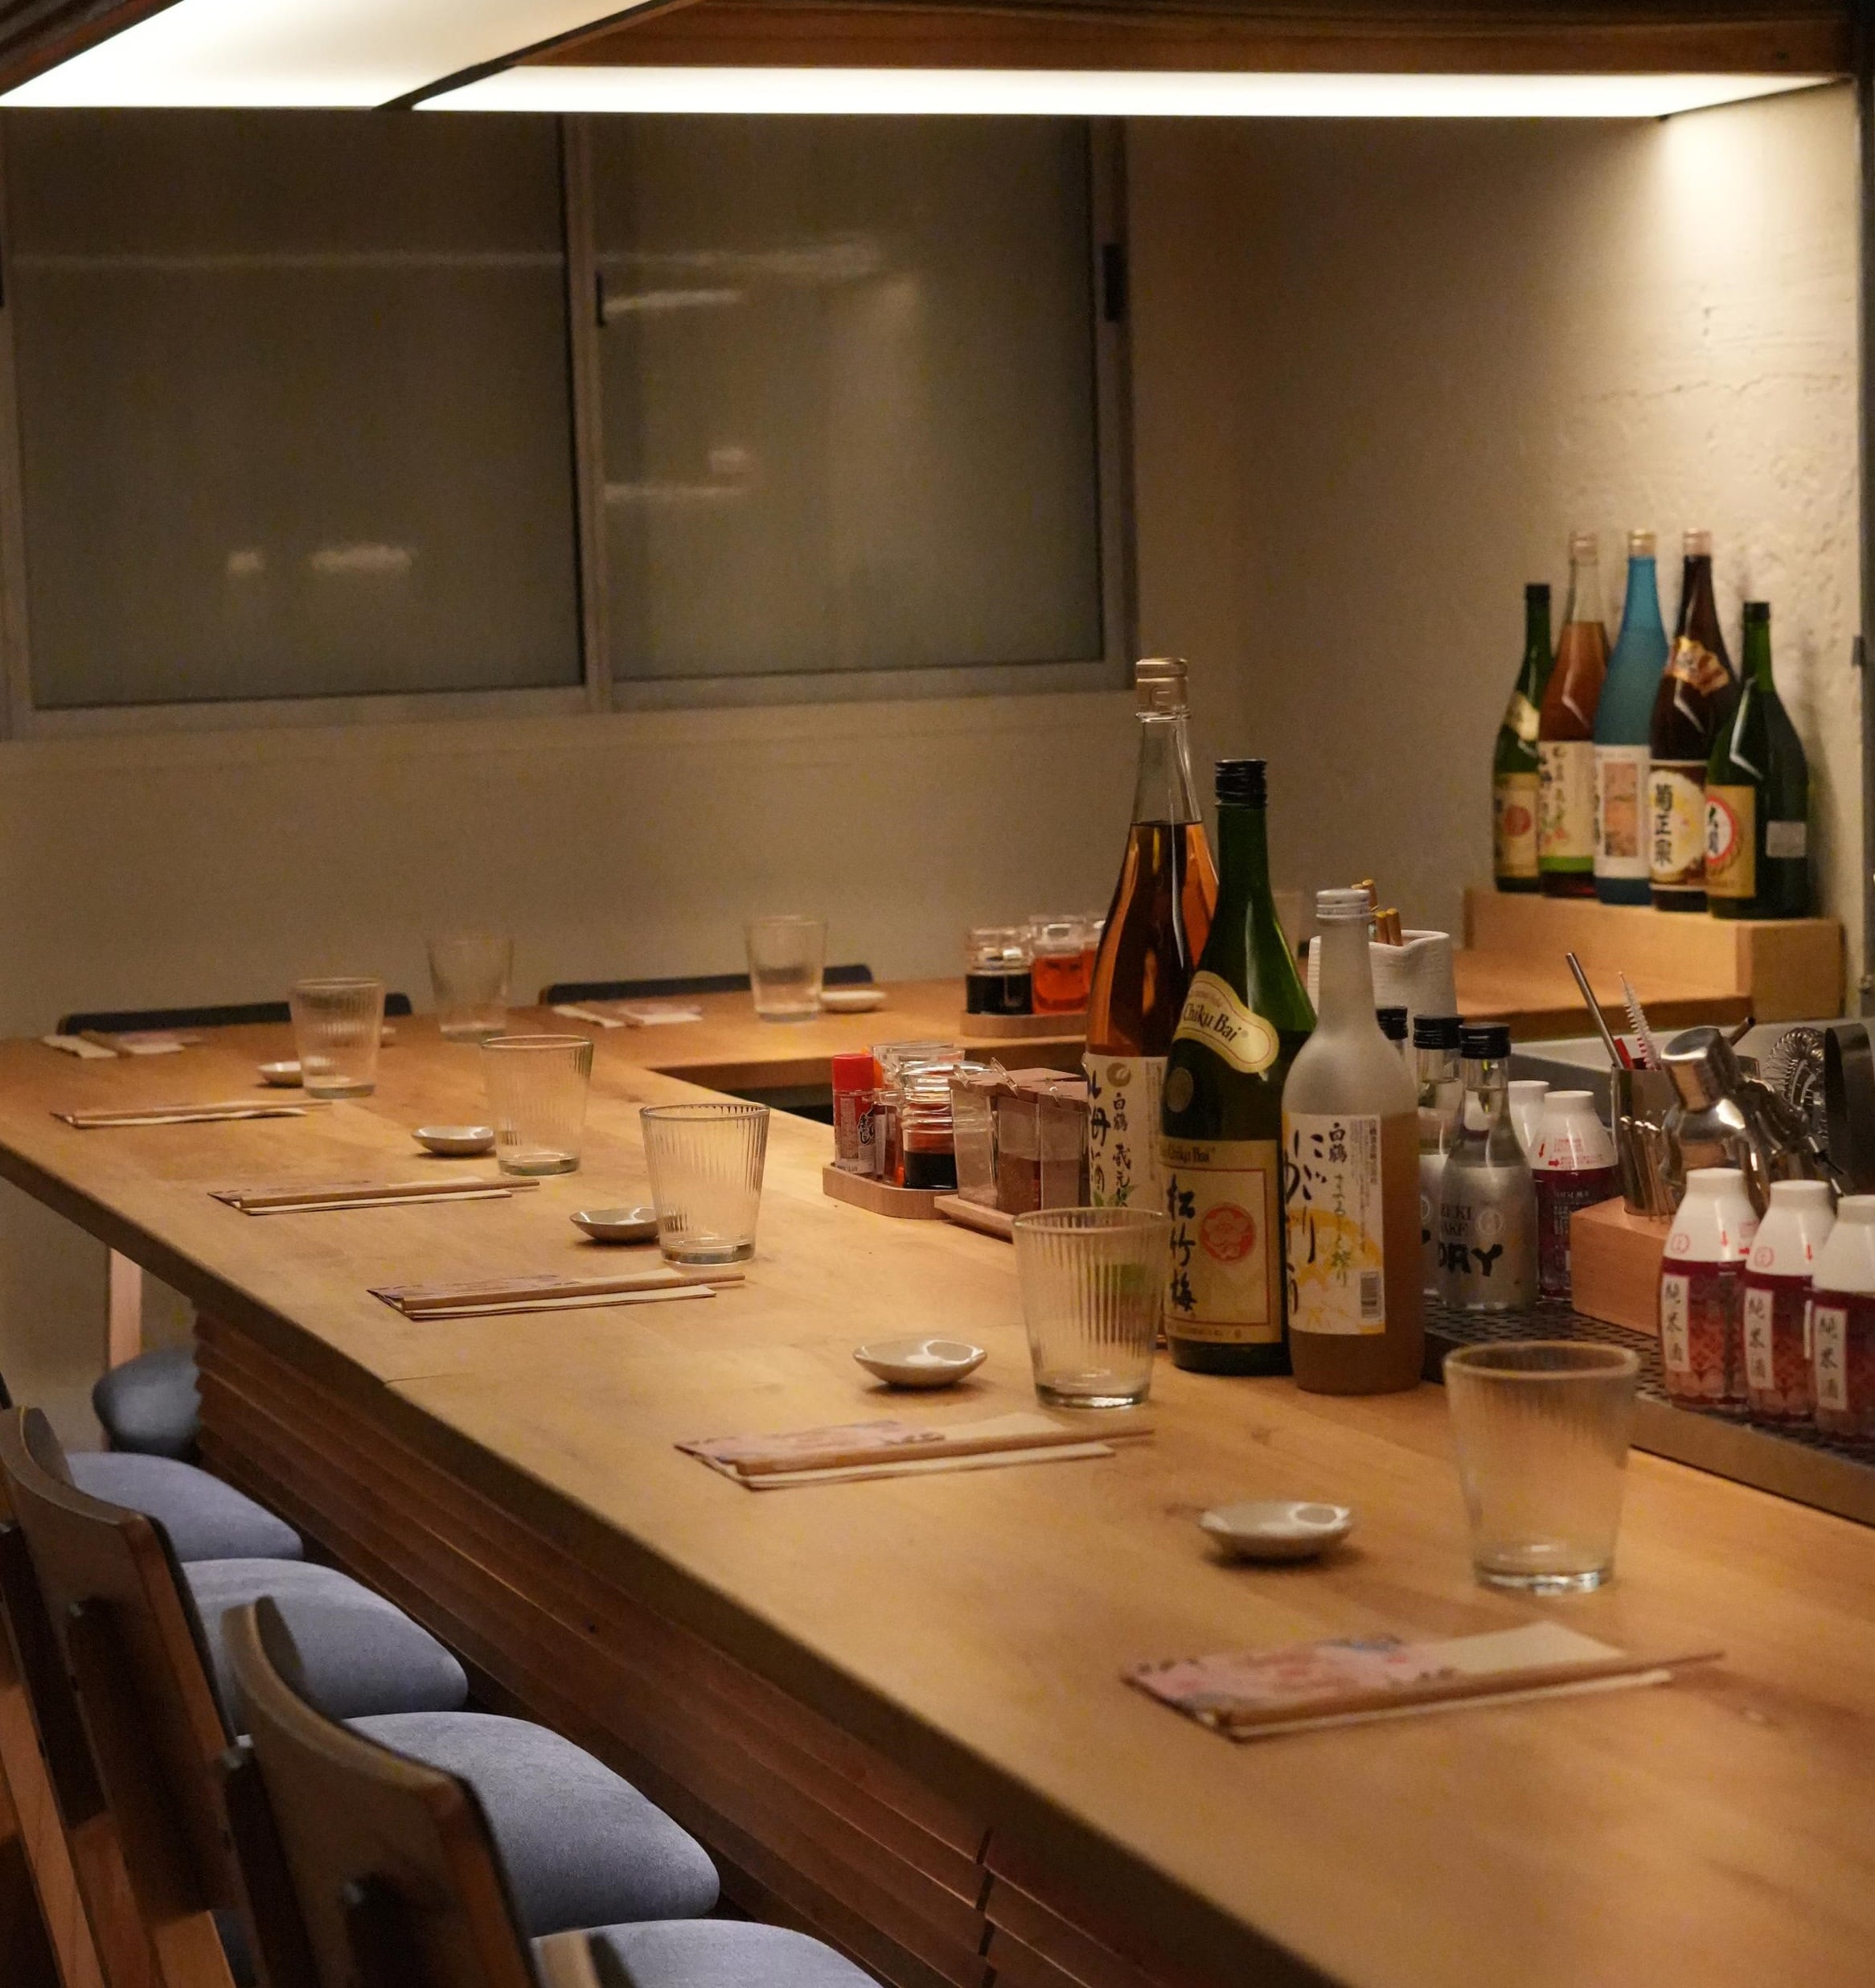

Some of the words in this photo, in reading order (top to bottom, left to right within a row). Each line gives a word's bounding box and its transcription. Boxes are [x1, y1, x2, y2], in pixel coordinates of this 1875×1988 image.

[1183, 1003, 1214, 1029] Chiku
[1214, 1013, 1242, 1043] Bai
[1167, 1173, 1196, 1312] 松竹梅
